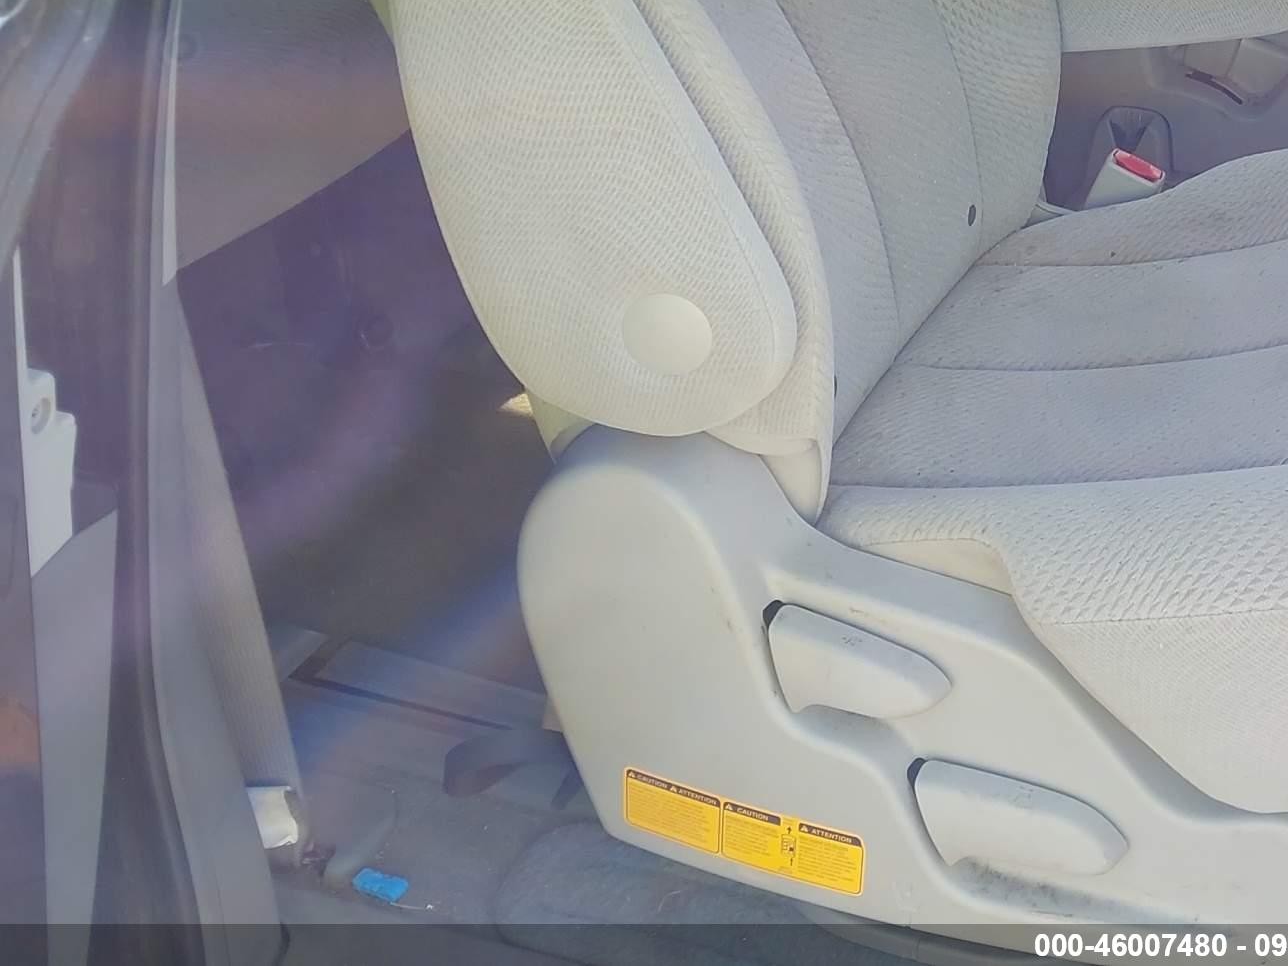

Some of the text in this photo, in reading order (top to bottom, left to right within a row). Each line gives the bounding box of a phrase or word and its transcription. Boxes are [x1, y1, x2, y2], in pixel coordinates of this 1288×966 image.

[637, 774, 717, 806] CAUTION ATTENTION
[736, 807, 769, 822] CAUTION
[811, 827, 852, 844] ATTENTION
